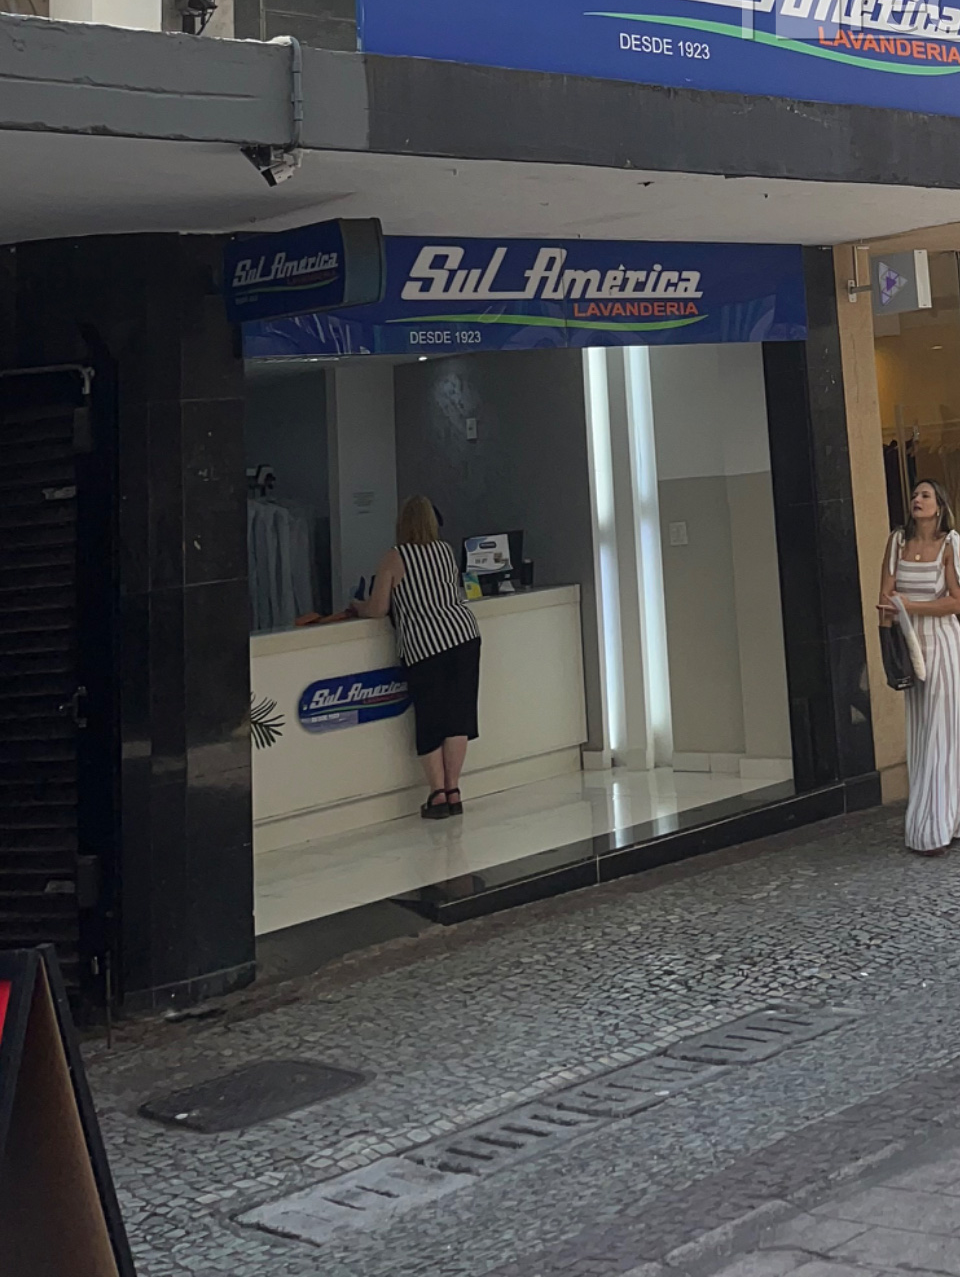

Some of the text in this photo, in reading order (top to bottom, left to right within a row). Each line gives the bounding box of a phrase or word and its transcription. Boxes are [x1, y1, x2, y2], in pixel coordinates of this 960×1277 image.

[619, 32, 711, 60] DESDE 1923
[231, 255, 267, 288] Sul
[401, 246, 703, 301] Sul América
[573, 301, 699, 318] LAVANDERIA
[409, 330, 482, 345] DESDE 1923
[309, 686, 344, 710] Sul
